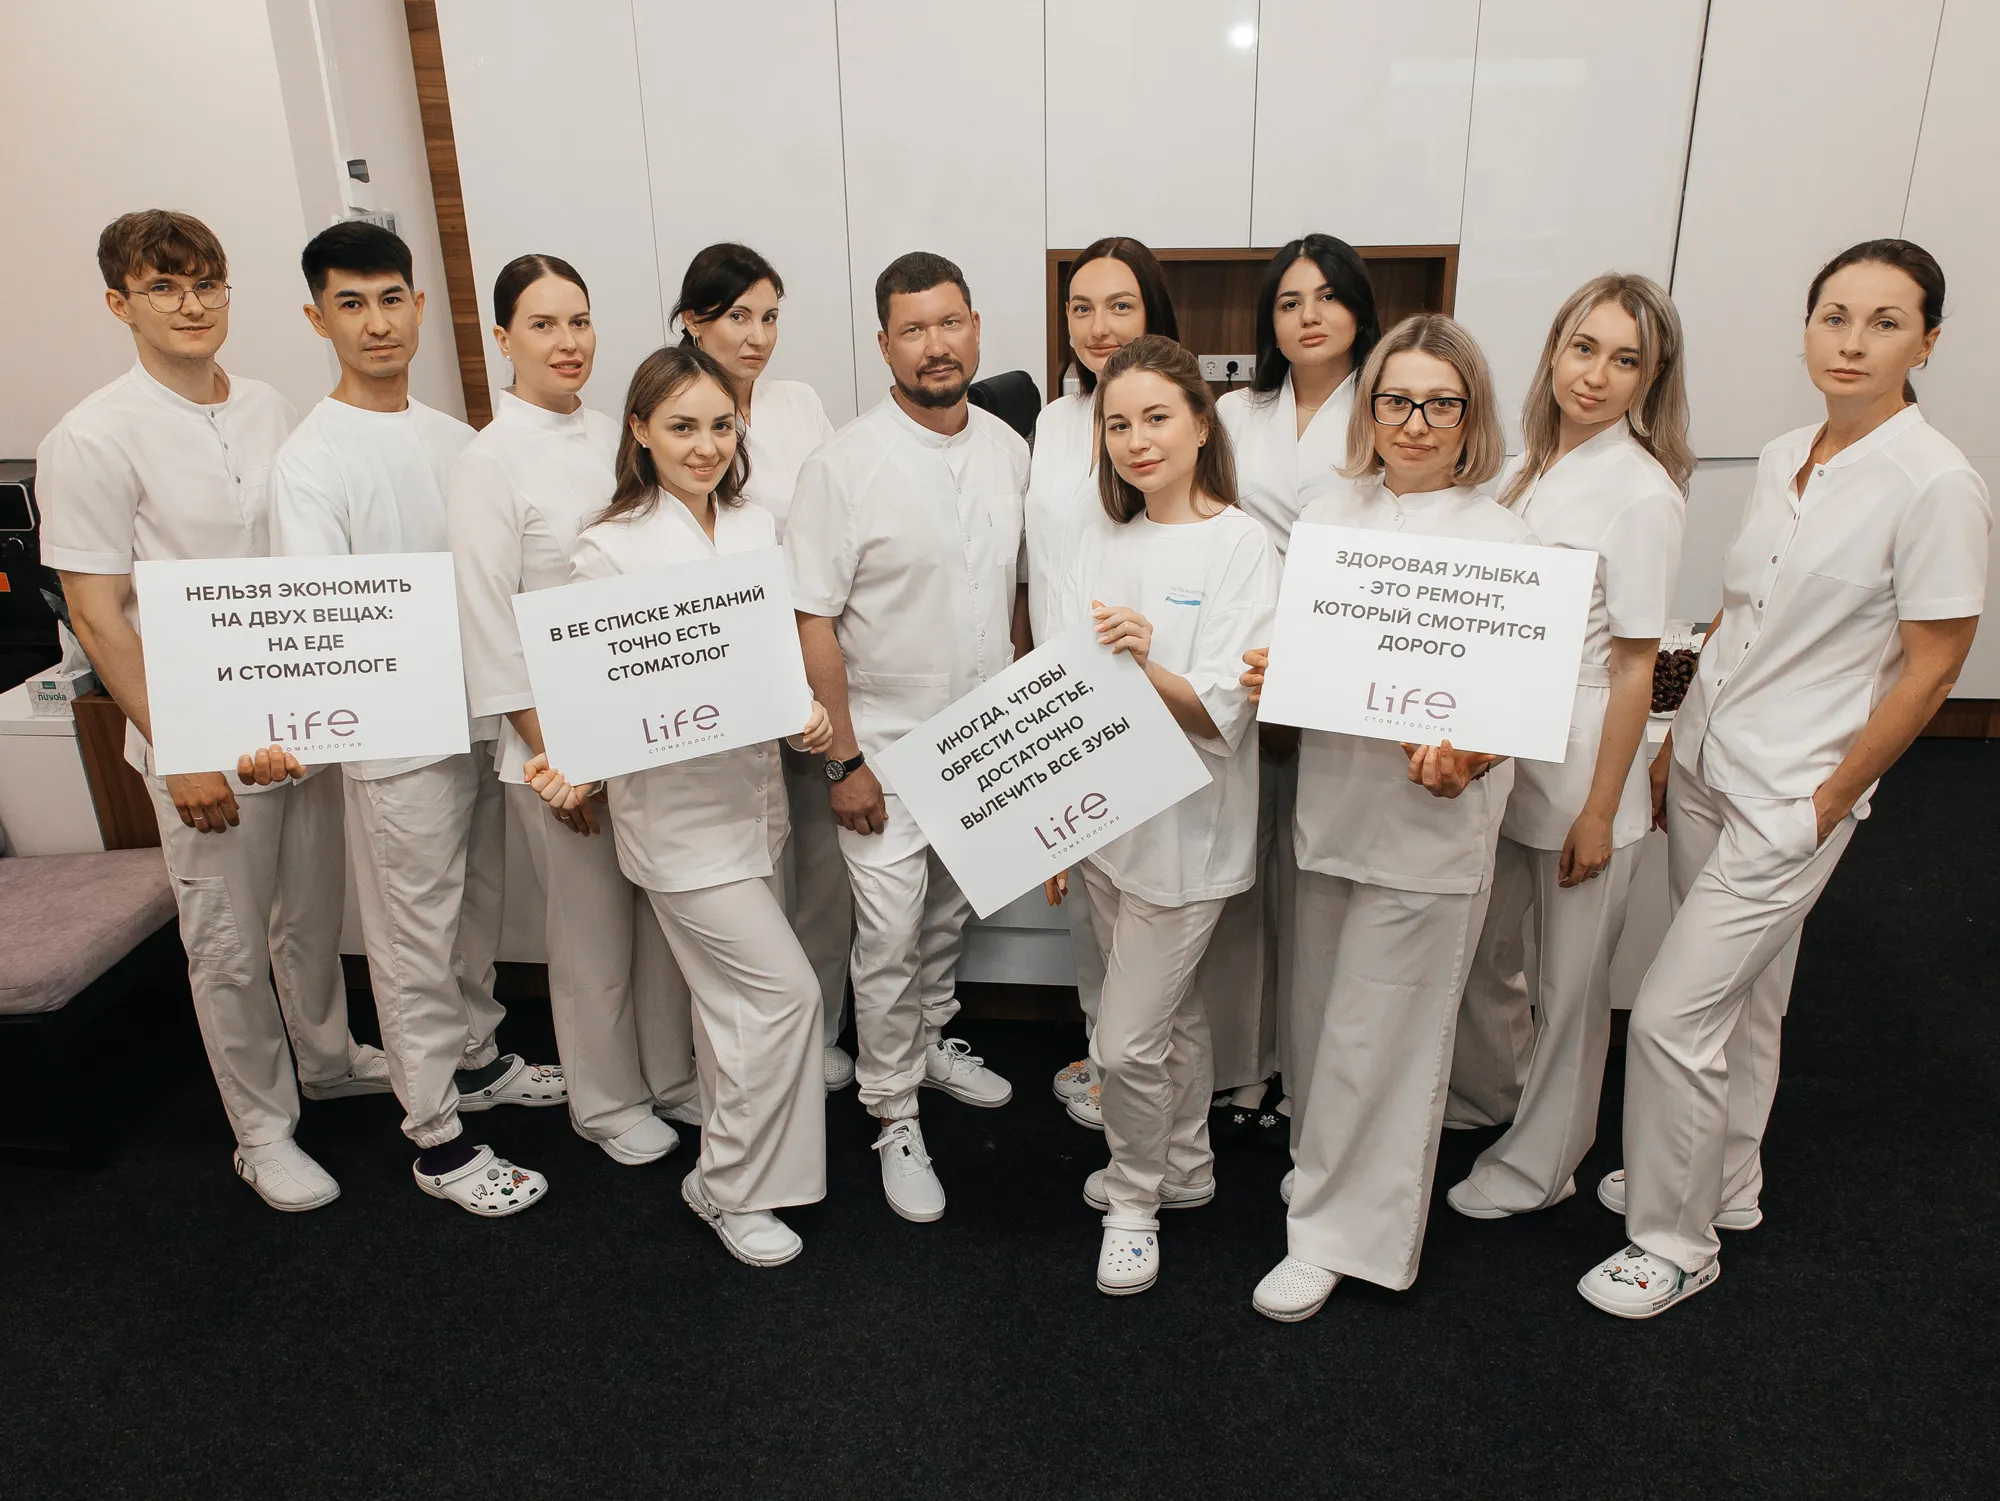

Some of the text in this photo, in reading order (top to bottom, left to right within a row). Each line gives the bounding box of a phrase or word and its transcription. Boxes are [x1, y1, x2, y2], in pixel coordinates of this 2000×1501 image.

[1336, 551, 1541, 587] ЗДОРОВАЯ УЛЫБКА
[186, 578, 412, 602] НЕЛЬЗЯ ЭКОНОМИТЬ
[1370, 581, 1411, 598] ЭТО
[1416, 586, 1505, 612] РЕМОНТ,
[211, 605, 394, 629] НА ДВУХ ВЕЩАХ:
[549, 585, 766, 643] В ЕЕ СПИСКЕ ЖЕЛАНИЙ
[1313, 599, 1547, 641] КОТОРЫЙ СМОТРИТСЯ
[268, 634, 345, 653] НА ЕДЕ
[607, 622, 721, 656] ТОЧНО ЕСТЬ
[1378, 635, 1466, 659] ДОРОГО
[218, 657, 398, 682] И СТОМАТОЛОГЕ
[607, 644, 731, 682] СТОМАТОЛОГ
[38, 692, 67, 701] nuvola
[936, 663, 1067, 756] ИНОГДА, ЧТОБЫ
[1366, 682, 1457, 719] Life
[267, 708, 360, 743] Life
[642, 705, 720, 745] Life
[940, 679, 1095, 782] ОБРЕСТИ СЧАСТЬЕ,
[1364, 716, 1453, 733] СТОМАТОЛОГИЯ
[286, 742, 363, 752] ОМАТОЛОГИЯ
[648, 732, 725, 754] СТОМАТОЛОГИЯ
[976, 715, 1084, 793] ДОСТАТОЧНО
[960, 716, 1131, 831] ВЫЛЕЧИТЬ ВСЕ ЗУБЫ
[1034, 793, 1109, 850] Life
[1052, 816, 1120, 859] СТОМАТОЛОГИЯ
